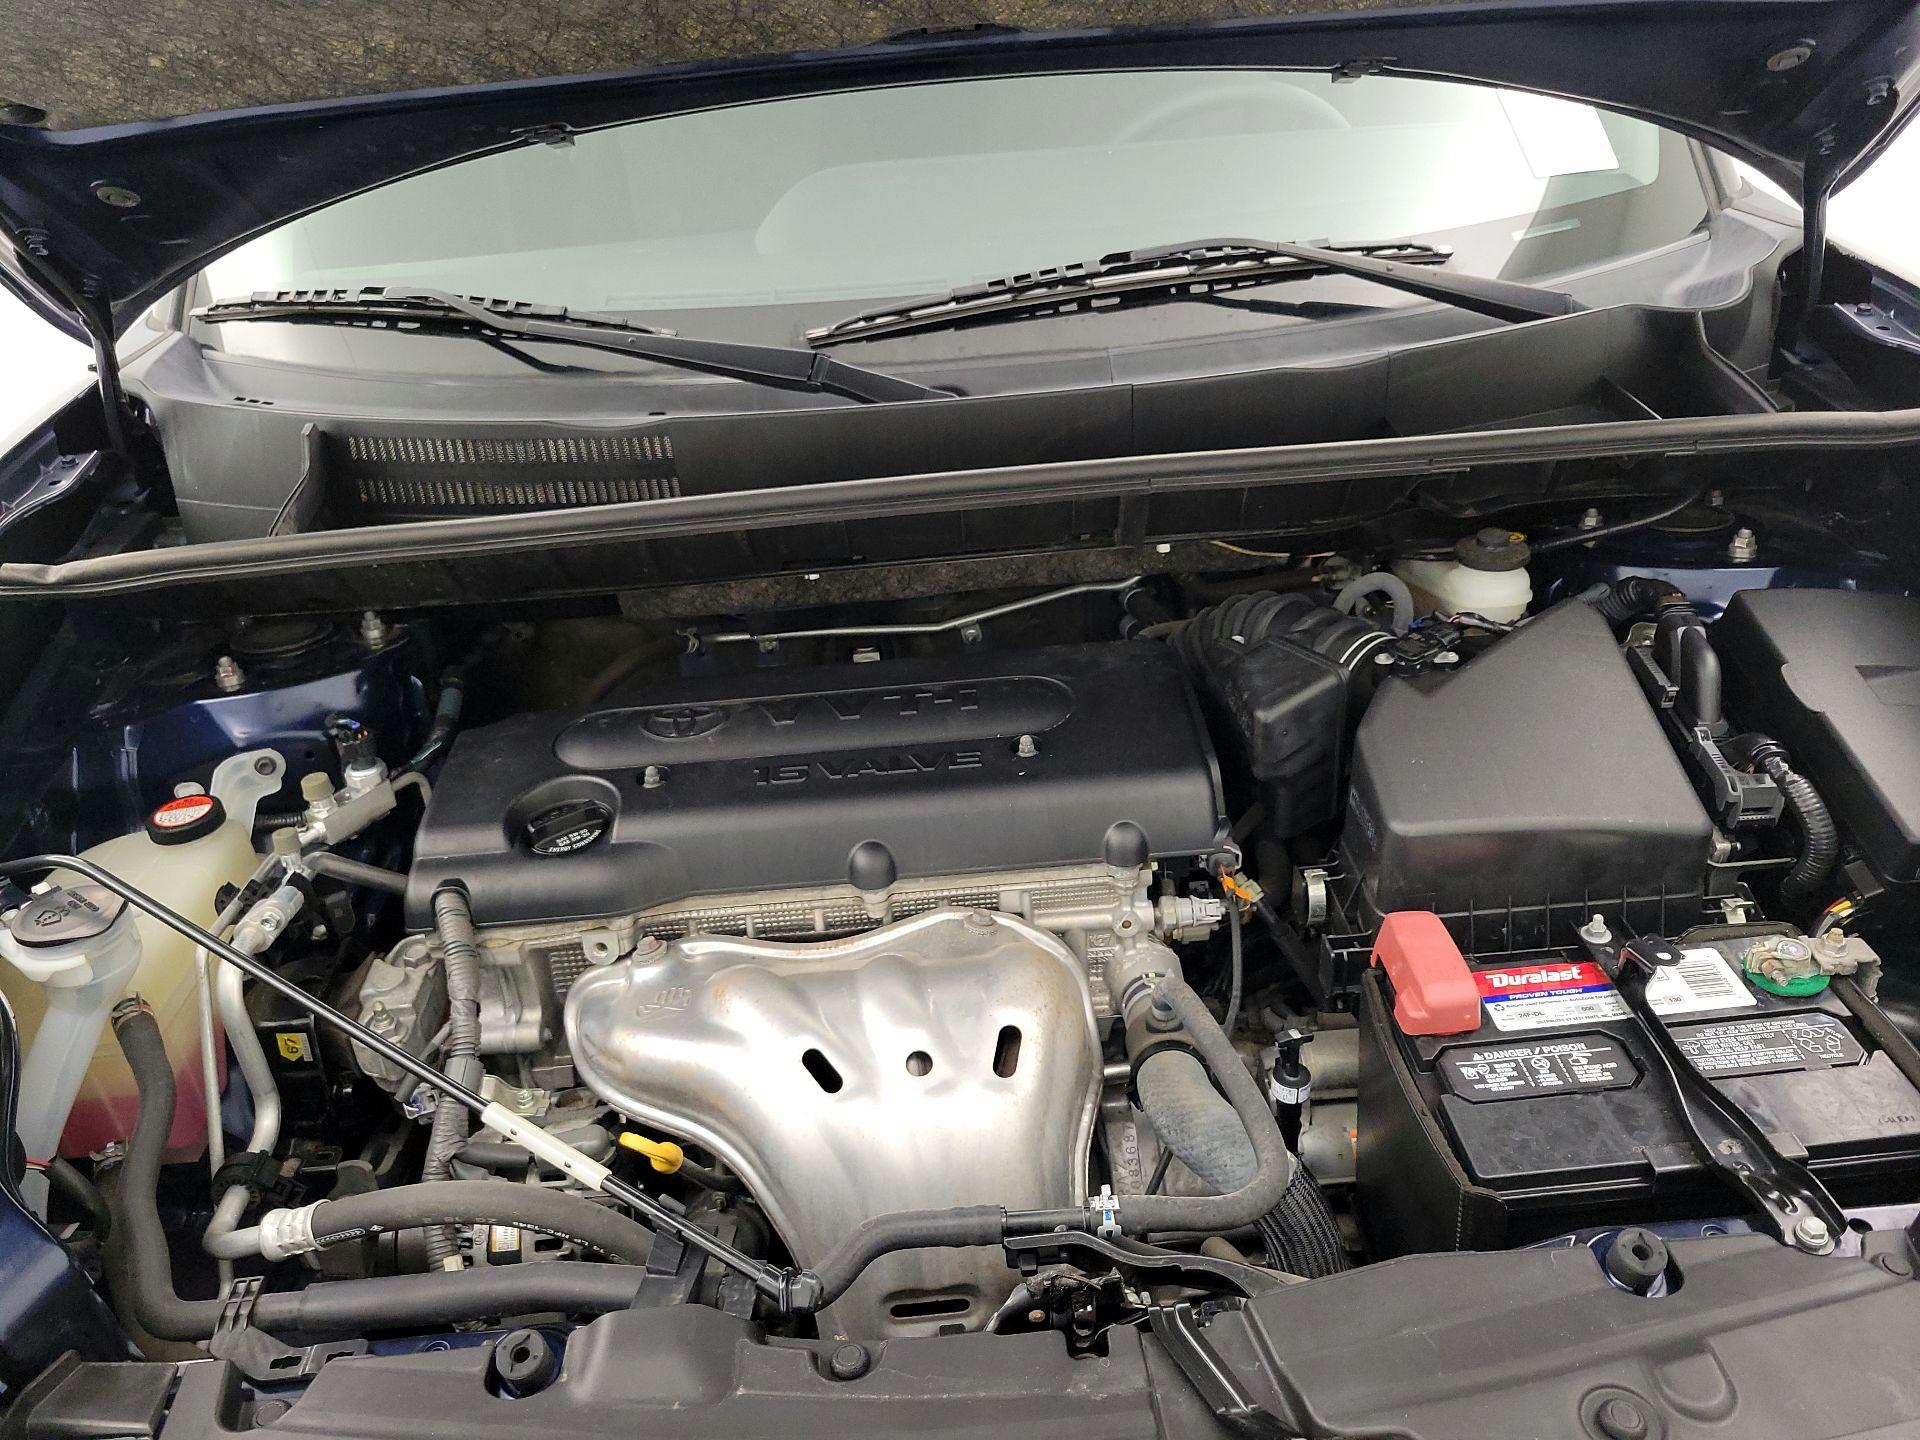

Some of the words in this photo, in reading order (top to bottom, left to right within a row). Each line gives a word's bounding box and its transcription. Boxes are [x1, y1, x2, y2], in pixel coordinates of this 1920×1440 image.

[753, 764, 808, 786] 16
[816, 751, 983, 780] VALVE
[548, 845, 572, 853] ENERGY
[1485, 965, 1583, 988] Duralast
[1509, 990, 1549, 1001] PROVEN
[1550, 987, 1583, 997] TOUGH
[1483, 1048, 1533, 1060] DANGER
[1541, 1042, 1587, 1054] POISON
